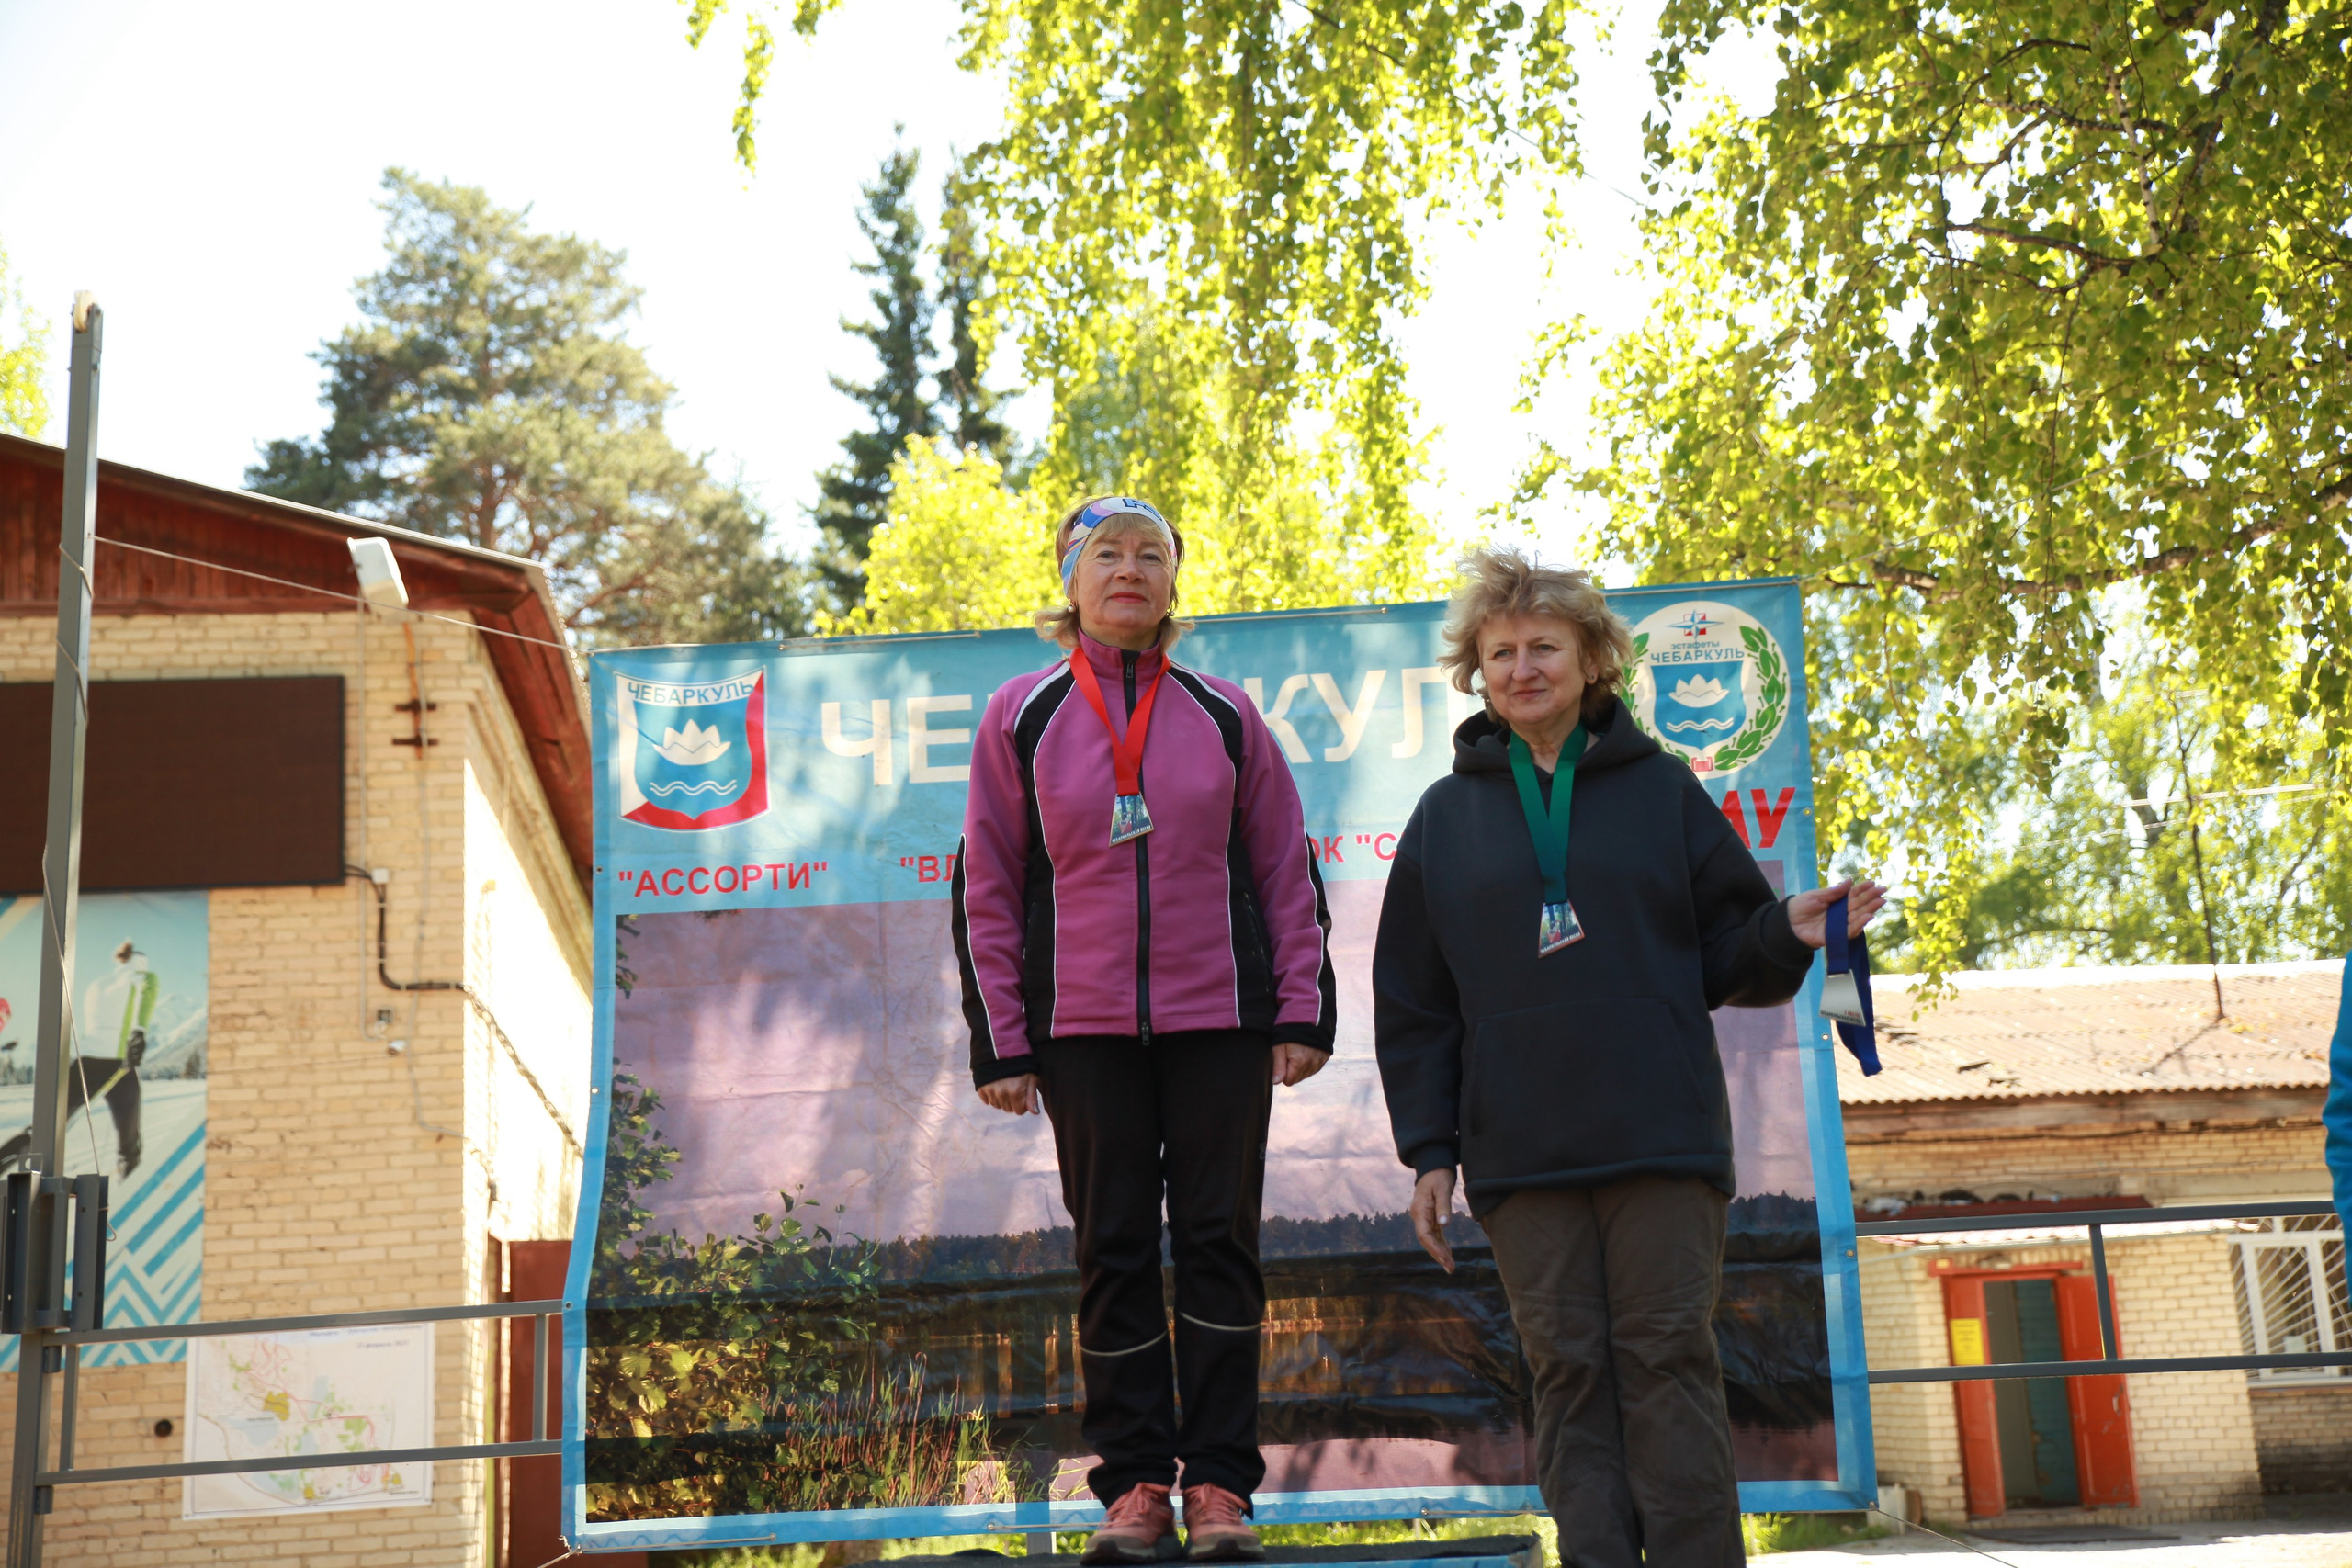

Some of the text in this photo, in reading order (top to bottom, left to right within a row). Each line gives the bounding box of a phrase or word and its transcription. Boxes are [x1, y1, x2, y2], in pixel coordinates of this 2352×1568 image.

[1651, 648, 1745, 663] ЧЕБАРКУЛЬ
[1671, 641, 1720, 650] эстафеты
[628, 681, 755, 705] ЧЕБАРКУЛЬ
[618, 862, 827, 897] "АССОРТИ"
[900, 854, 958, 882] "ВЛ
